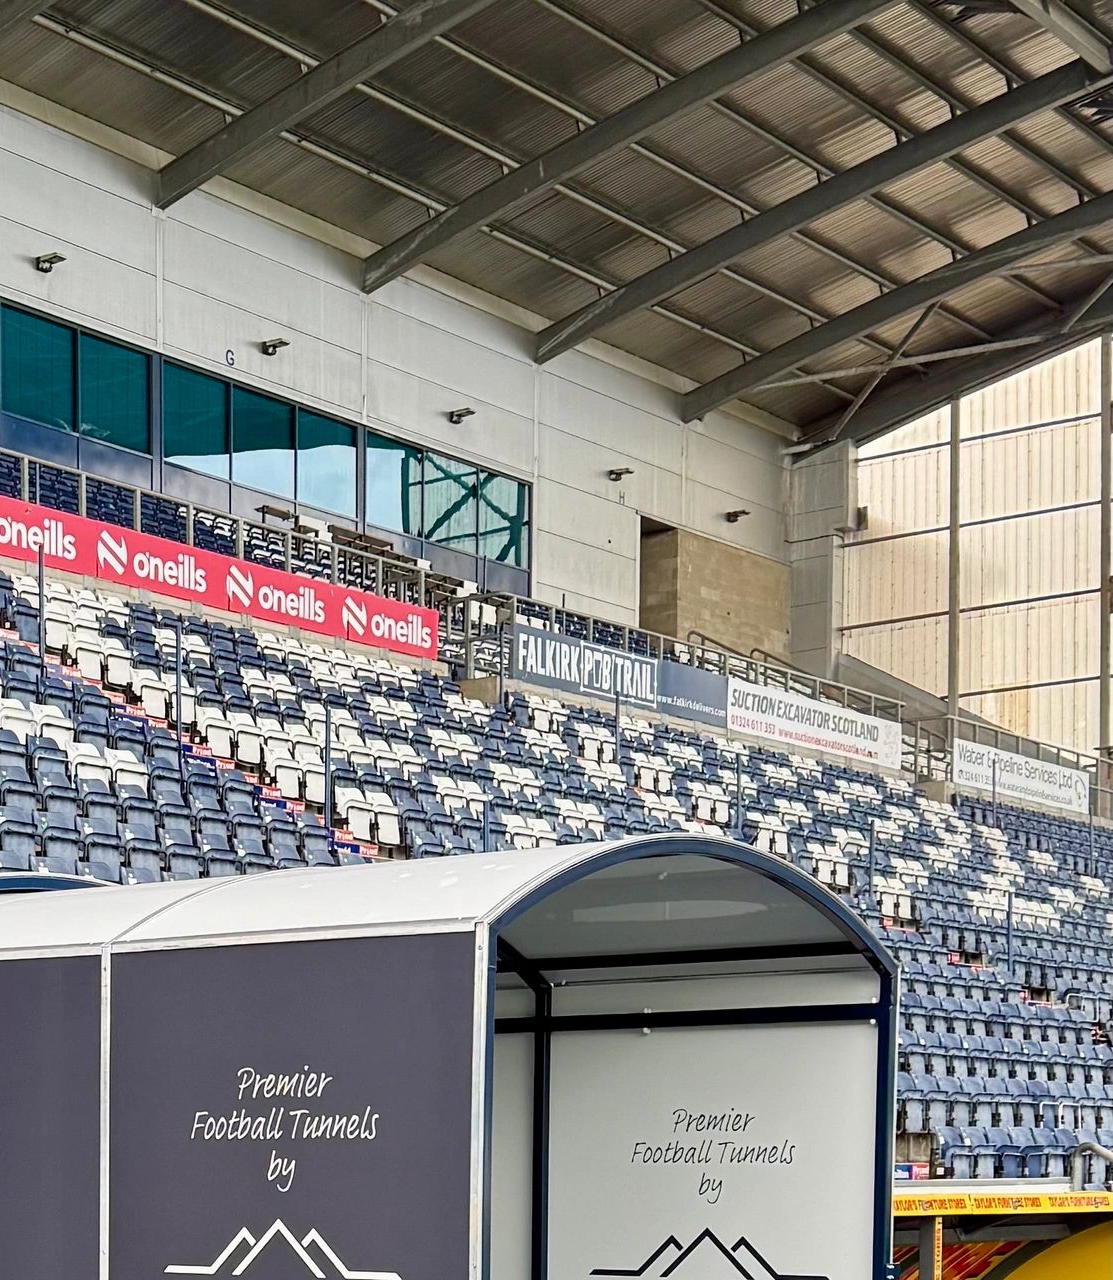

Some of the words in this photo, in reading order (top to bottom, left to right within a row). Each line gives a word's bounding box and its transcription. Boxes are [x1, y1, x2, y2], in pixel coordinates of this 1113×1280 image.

[225, 349, 236, 367] G
[518, 633, 580, 683] FALKIRK
[615, 658, 654, 699] TRAIL
[731, 688, 776, 717] SUCTION
[776, 700, 830, 731] EXCAVATOR
[831, 715, 879, 743] SCOTLAND
[958, 743, 985, 768] Water
[1024, 761, 1057, 785] Services
[1058, 769, 1073, 790] Ltd
[236, 1065, 333, 1100] Premier
[190, 1108, 284, 1141] Football
[288, 1105, 380, 1141] Tunnels
[672, 1107, 756, 1133] Premier
[631, 1140, 712, 1165] Football
[718, 1139, 796, 1165] Tunnels
[267, 1150, 296, 1192] by
[698, 1172, 724, 1204] by
